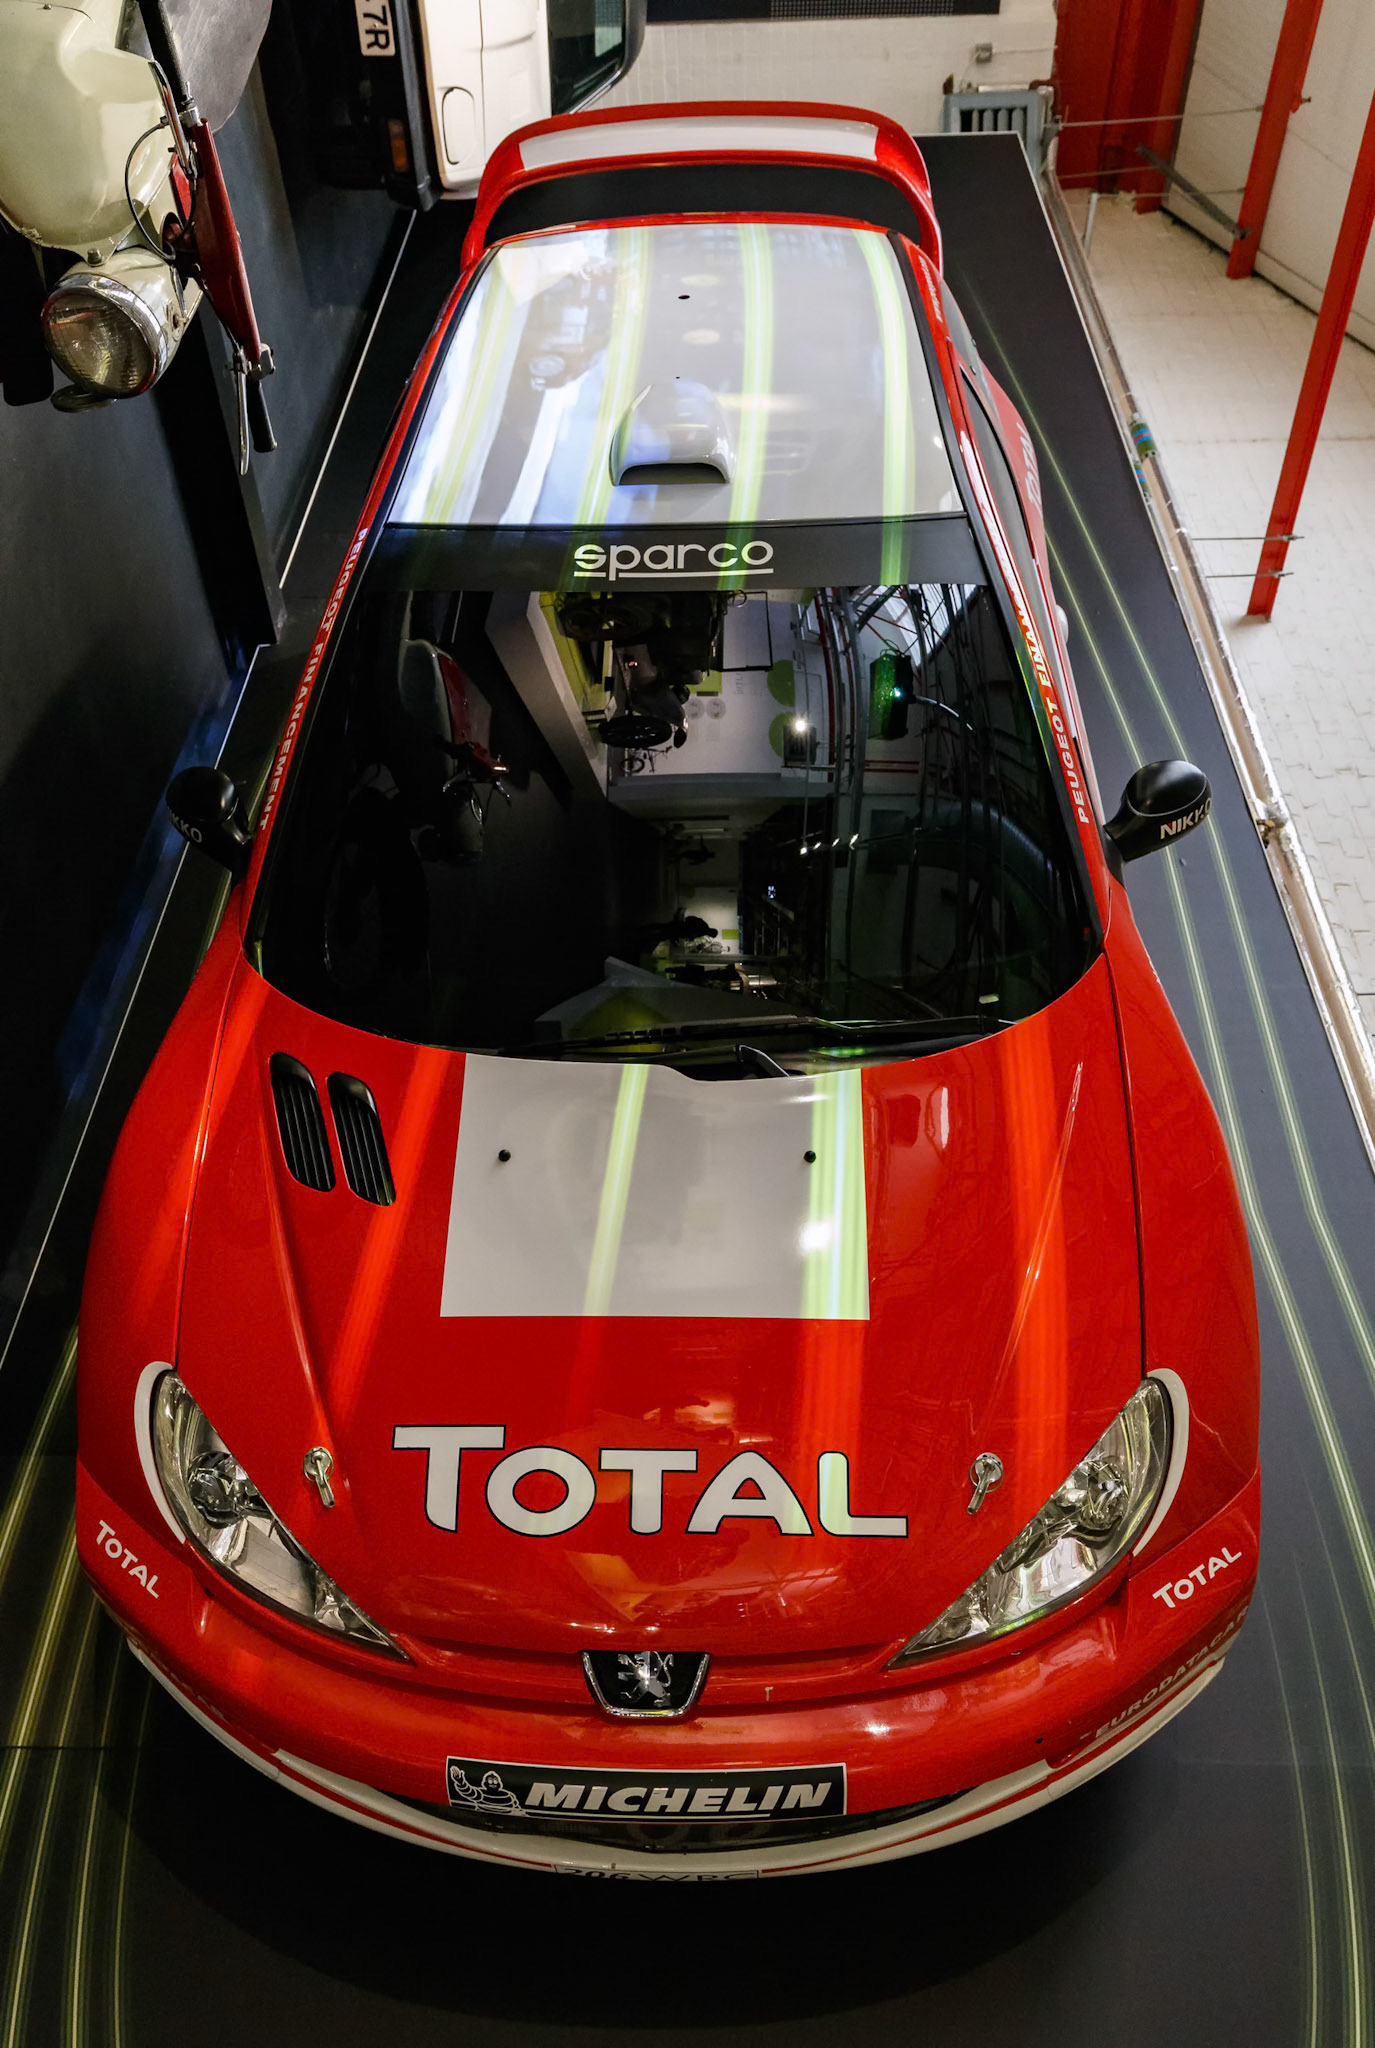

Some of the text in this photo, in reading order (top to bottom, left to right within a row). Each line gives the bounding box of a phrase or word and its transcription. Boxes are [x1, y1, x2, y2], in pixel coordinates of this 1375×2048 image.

[574, 540, 774, 582] sparco
[260, 527, 369, 830] PEUGEOT FINANCEMENT
[1046, 697, 1090, 824] PEUGEOT
[1160, 797, 1212, 840] NIKKO
[392, 1424, 909, 1538] TOTAL
[96, 1519, 159, 1599] TOTAL
[1152, 1546, 1243, 1609] TOTAL
[524, 1781, 832, 1813] MICHELIN
